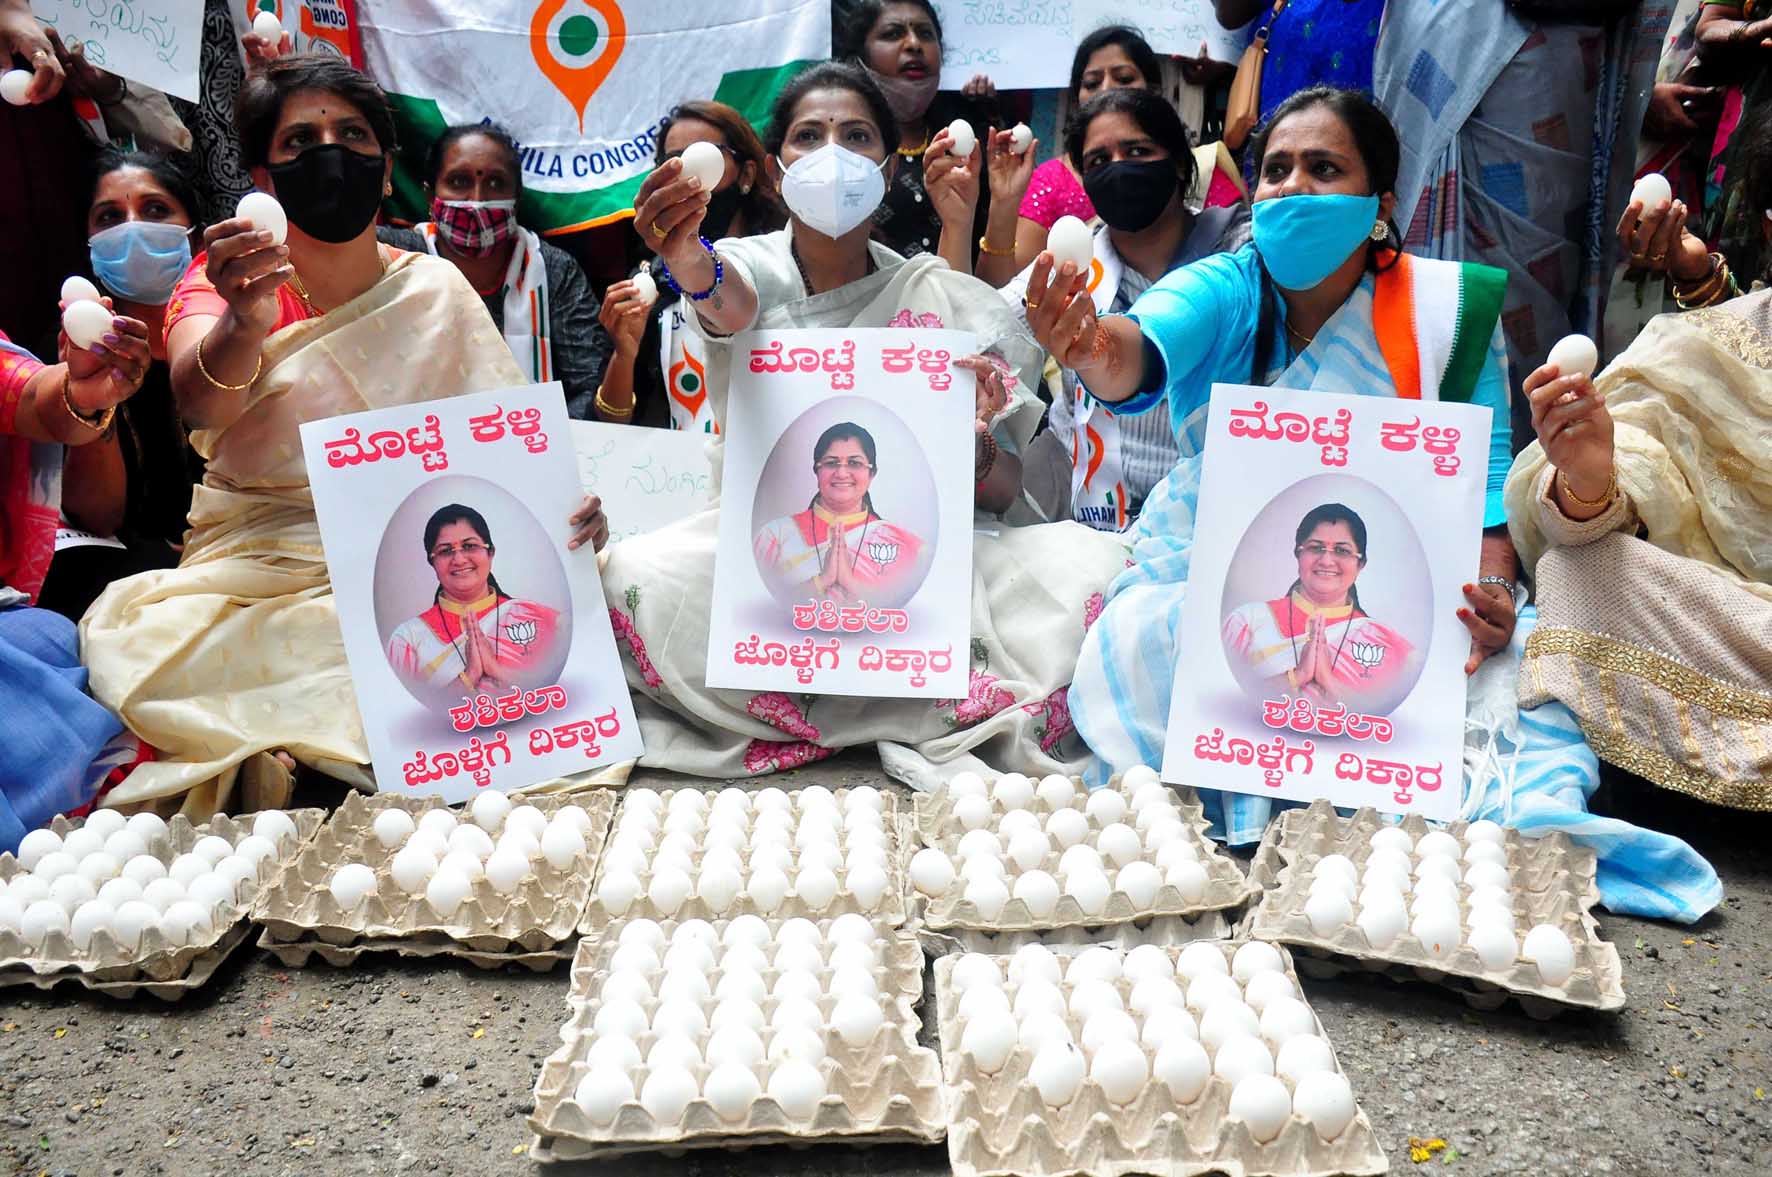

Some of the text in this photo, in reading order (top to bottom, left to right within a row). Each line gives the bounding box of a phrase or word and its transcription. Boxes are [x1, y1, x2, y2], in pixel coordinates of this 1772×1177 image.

[750, 340, 952, 391] ಮೊಟ್ಟೆ ಕಳ್ಳಿ
[324, 404, 548, 472] ಮೊಟ್ಟೆ ಕಳ್ಳಿ
[1228, 401, 1461, 477] ಮೊಟ್ಟೆ ಕಳ್ಳಿ
[793, 598, 910, 634] ಶಶಿಕಲಾ
[858, 643, 953, 688] ದಿಕ್ಕಾರ
[449, 684, 568, 732] ಶಶಿಕಲಾ
[528, 706, 621, 758] ದಿಕ್ಕಾರ
[1263, 694, 1393, 743] ಶಶಿಕಲಾ
[1335, 752, 1443, 805] ದಿಕ್ಕಾರ
